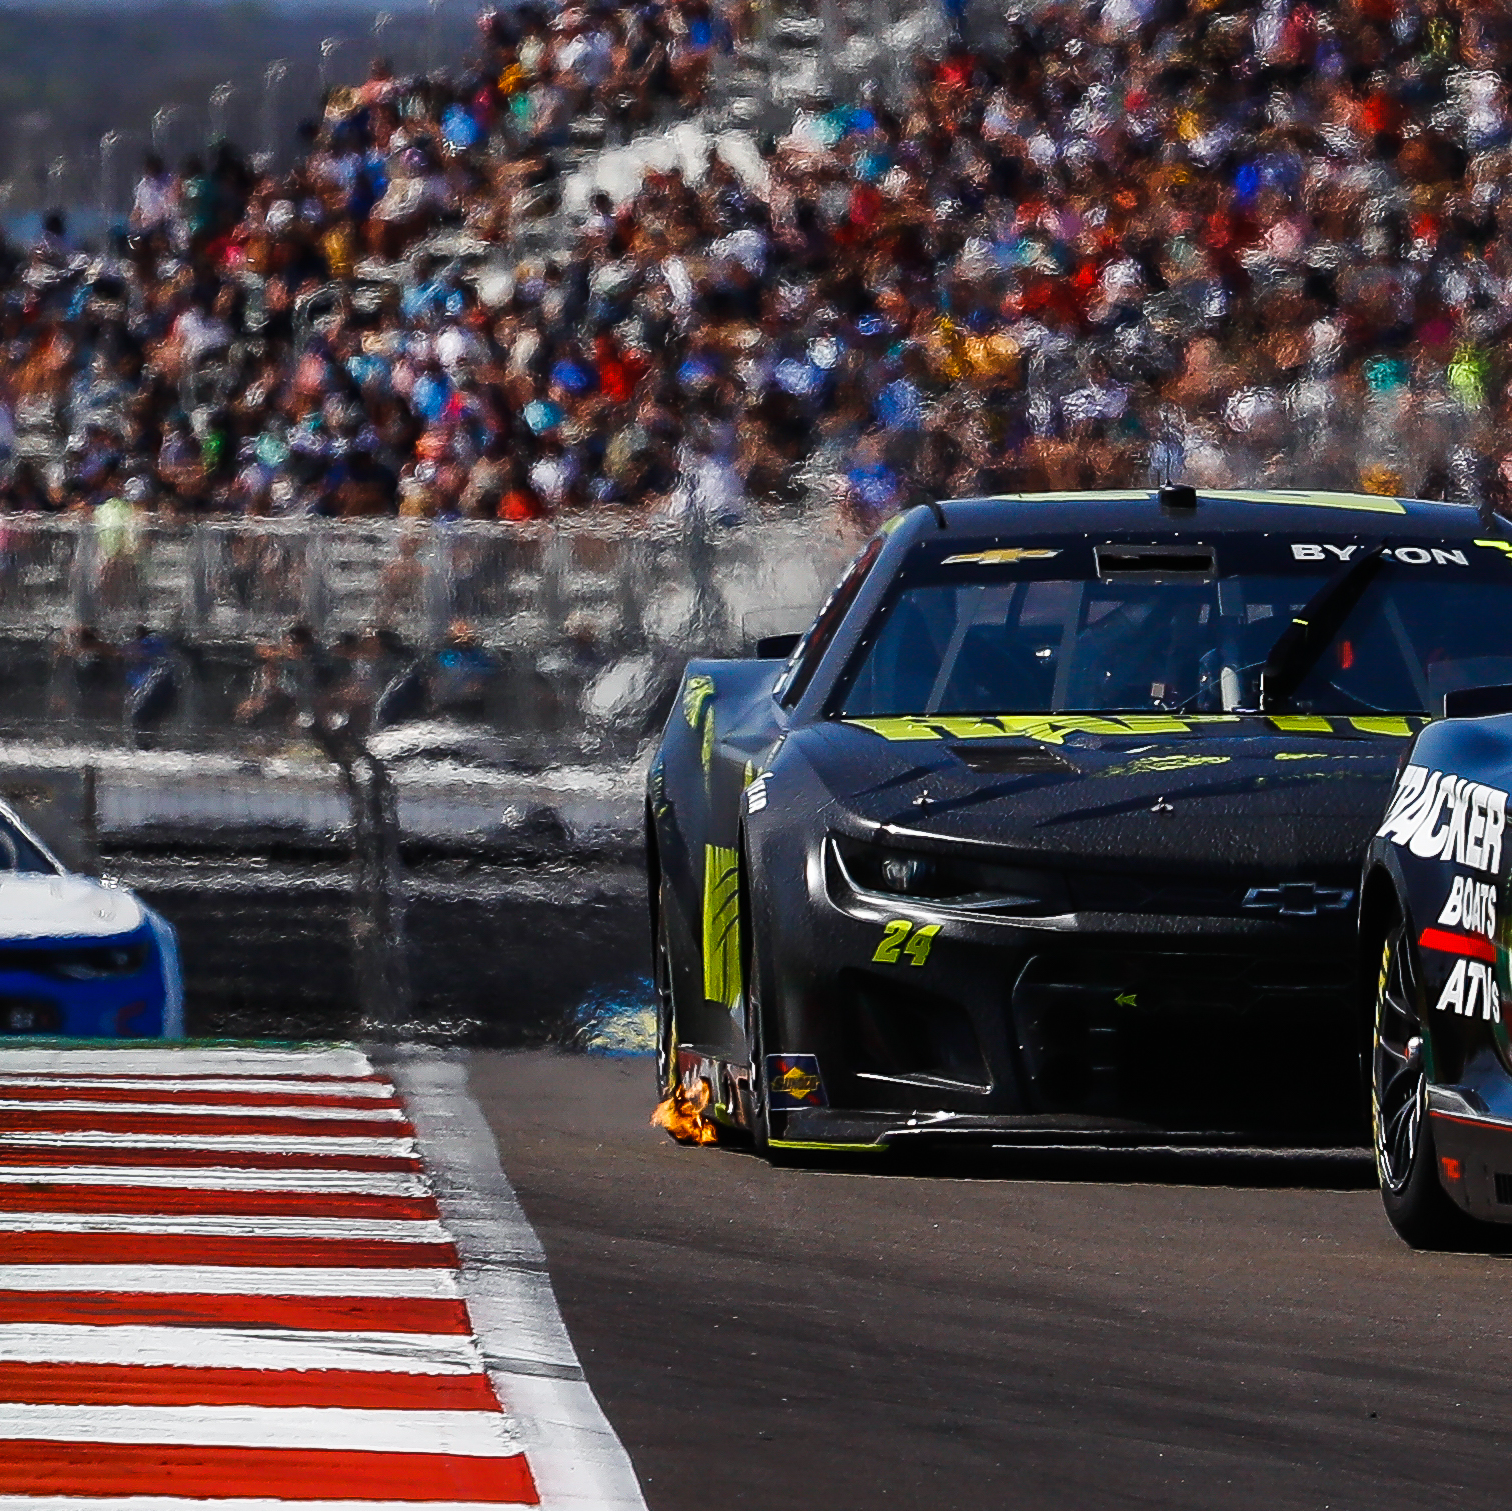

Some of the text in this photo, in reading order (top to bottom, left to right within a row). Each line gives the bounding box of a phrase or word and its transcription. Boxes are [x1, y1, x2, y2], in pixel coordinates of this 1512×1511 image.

[1290, 543, 1470, 567] BYON
[1375, 764, 1509, 875] TRACKER
[1437, 875, 1498, 940] BOATS
[872, 919, 944, 966] 24
